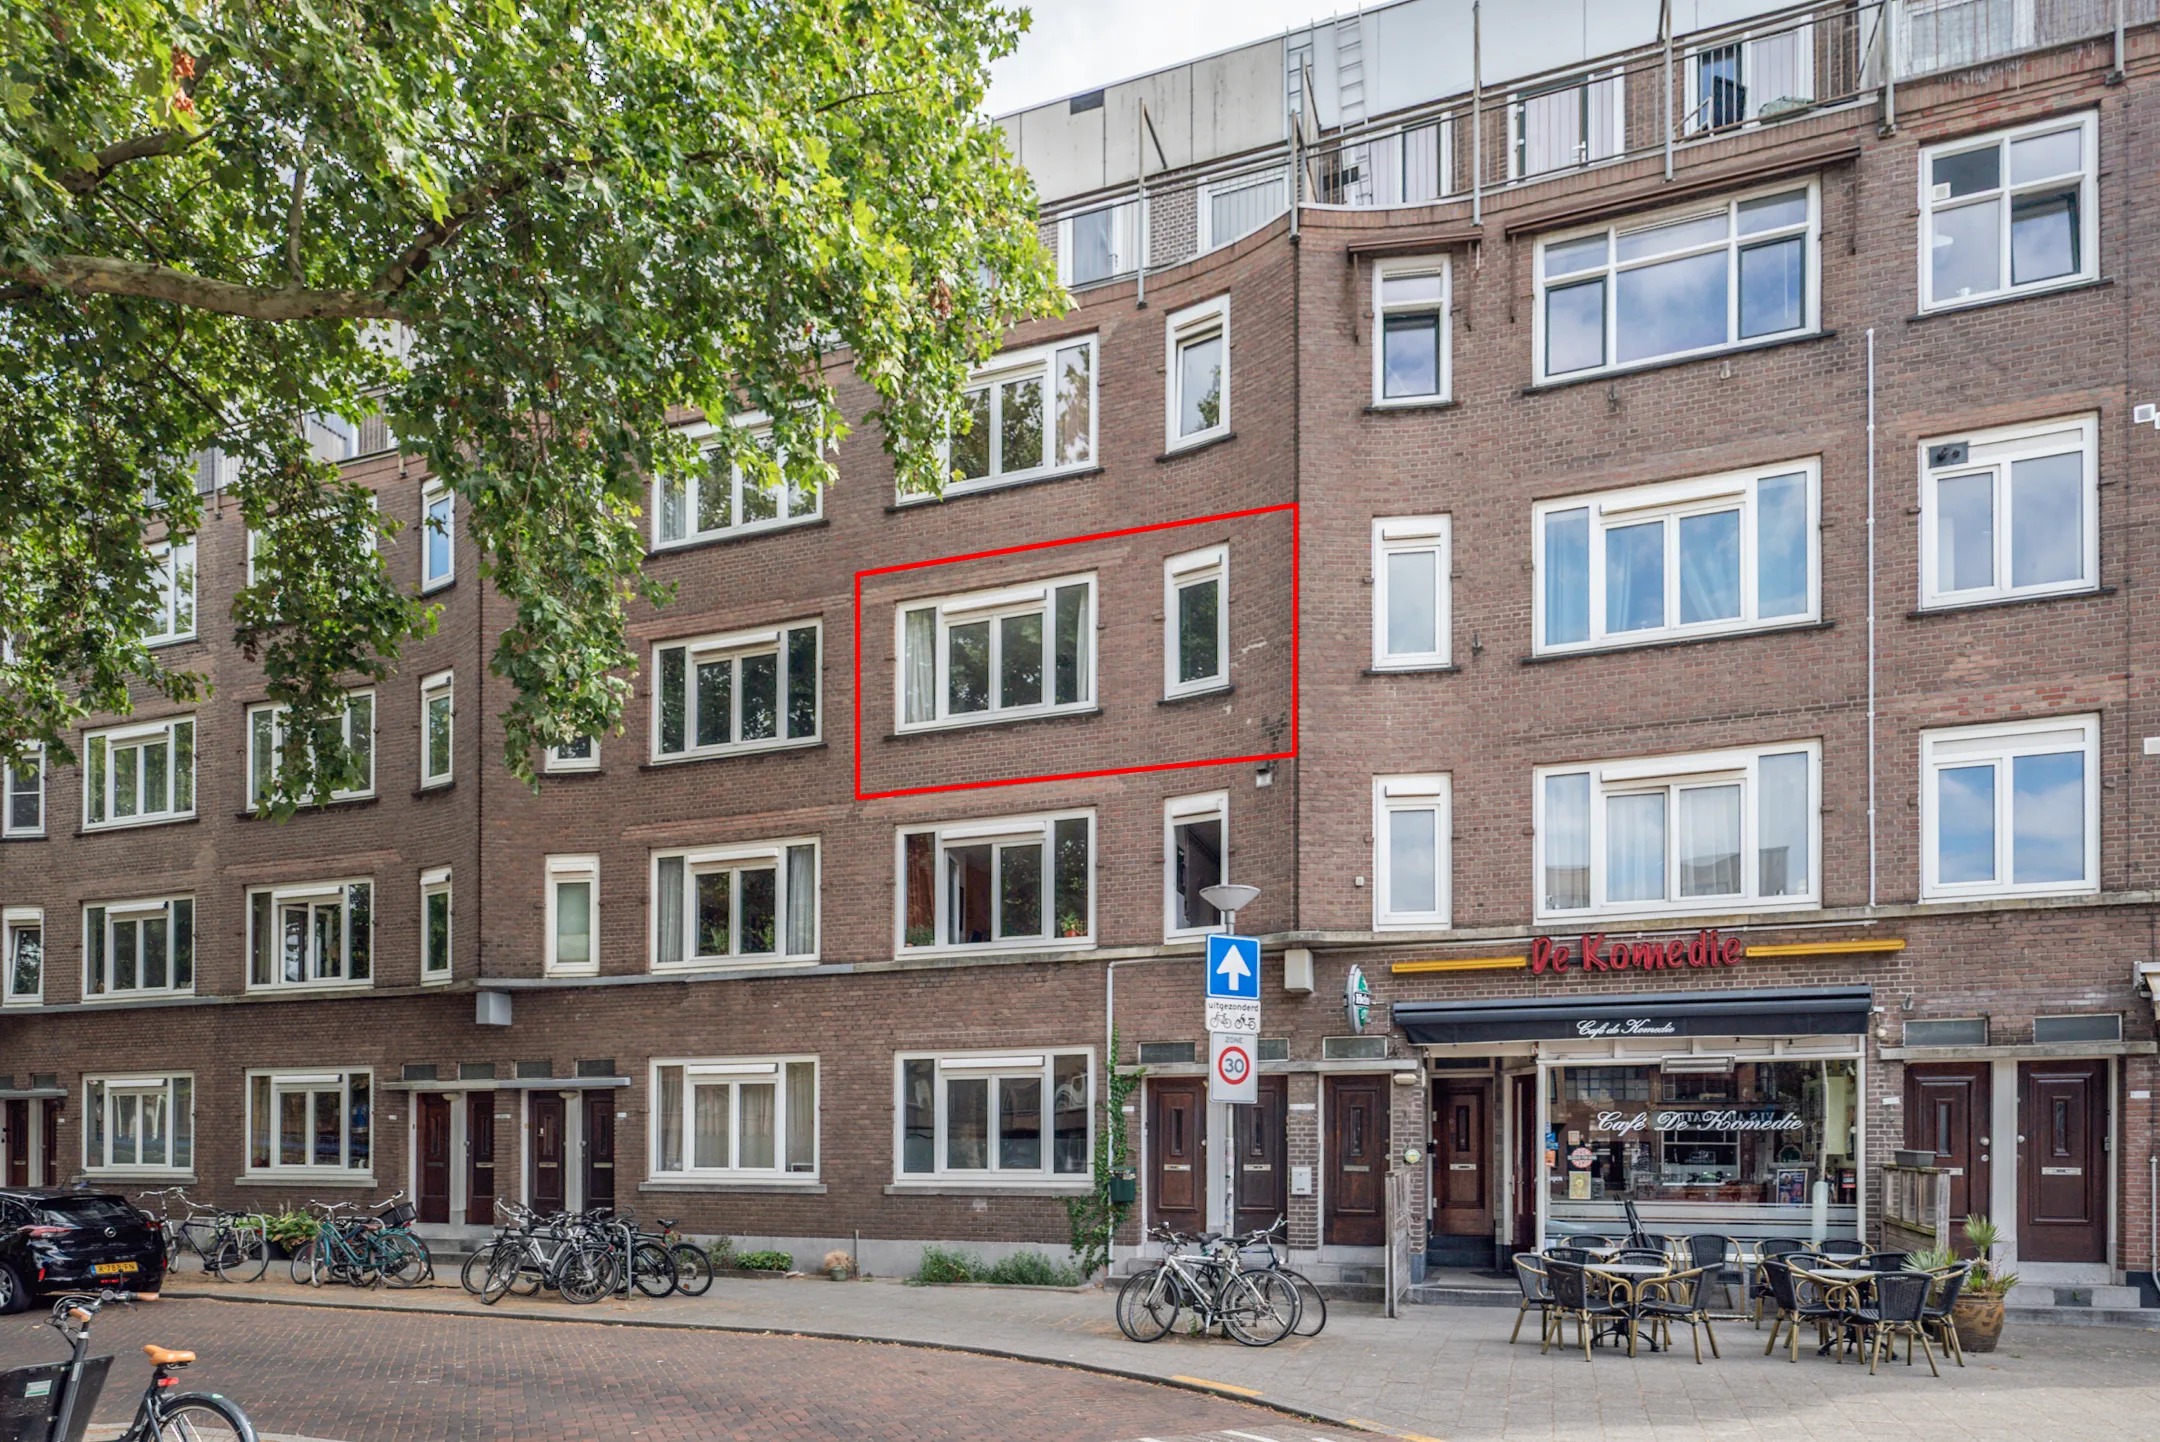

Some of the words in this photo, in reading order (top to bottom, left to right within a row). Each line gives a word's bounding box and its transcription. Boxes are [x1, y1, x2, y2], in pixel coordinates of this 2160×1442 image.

[1531, 936, 1570, 975] De
[1580, 929, 1741, 972] Komedie
[1208, 1002, 1259, 1012] uitgezonderd
[1606, 1023, 1621, 1034] de
[1621, 1019, 1676, 1034] Komedie
[1224, 1036, 1244, 1044] ZONE
[1224, 1058, 1245, 1073] 30
[1597, 1111, 1648, 1137] Café
[1654, 1111, 1689, 1131] De
[1696, 1110, 1804, 1131] Komedie
